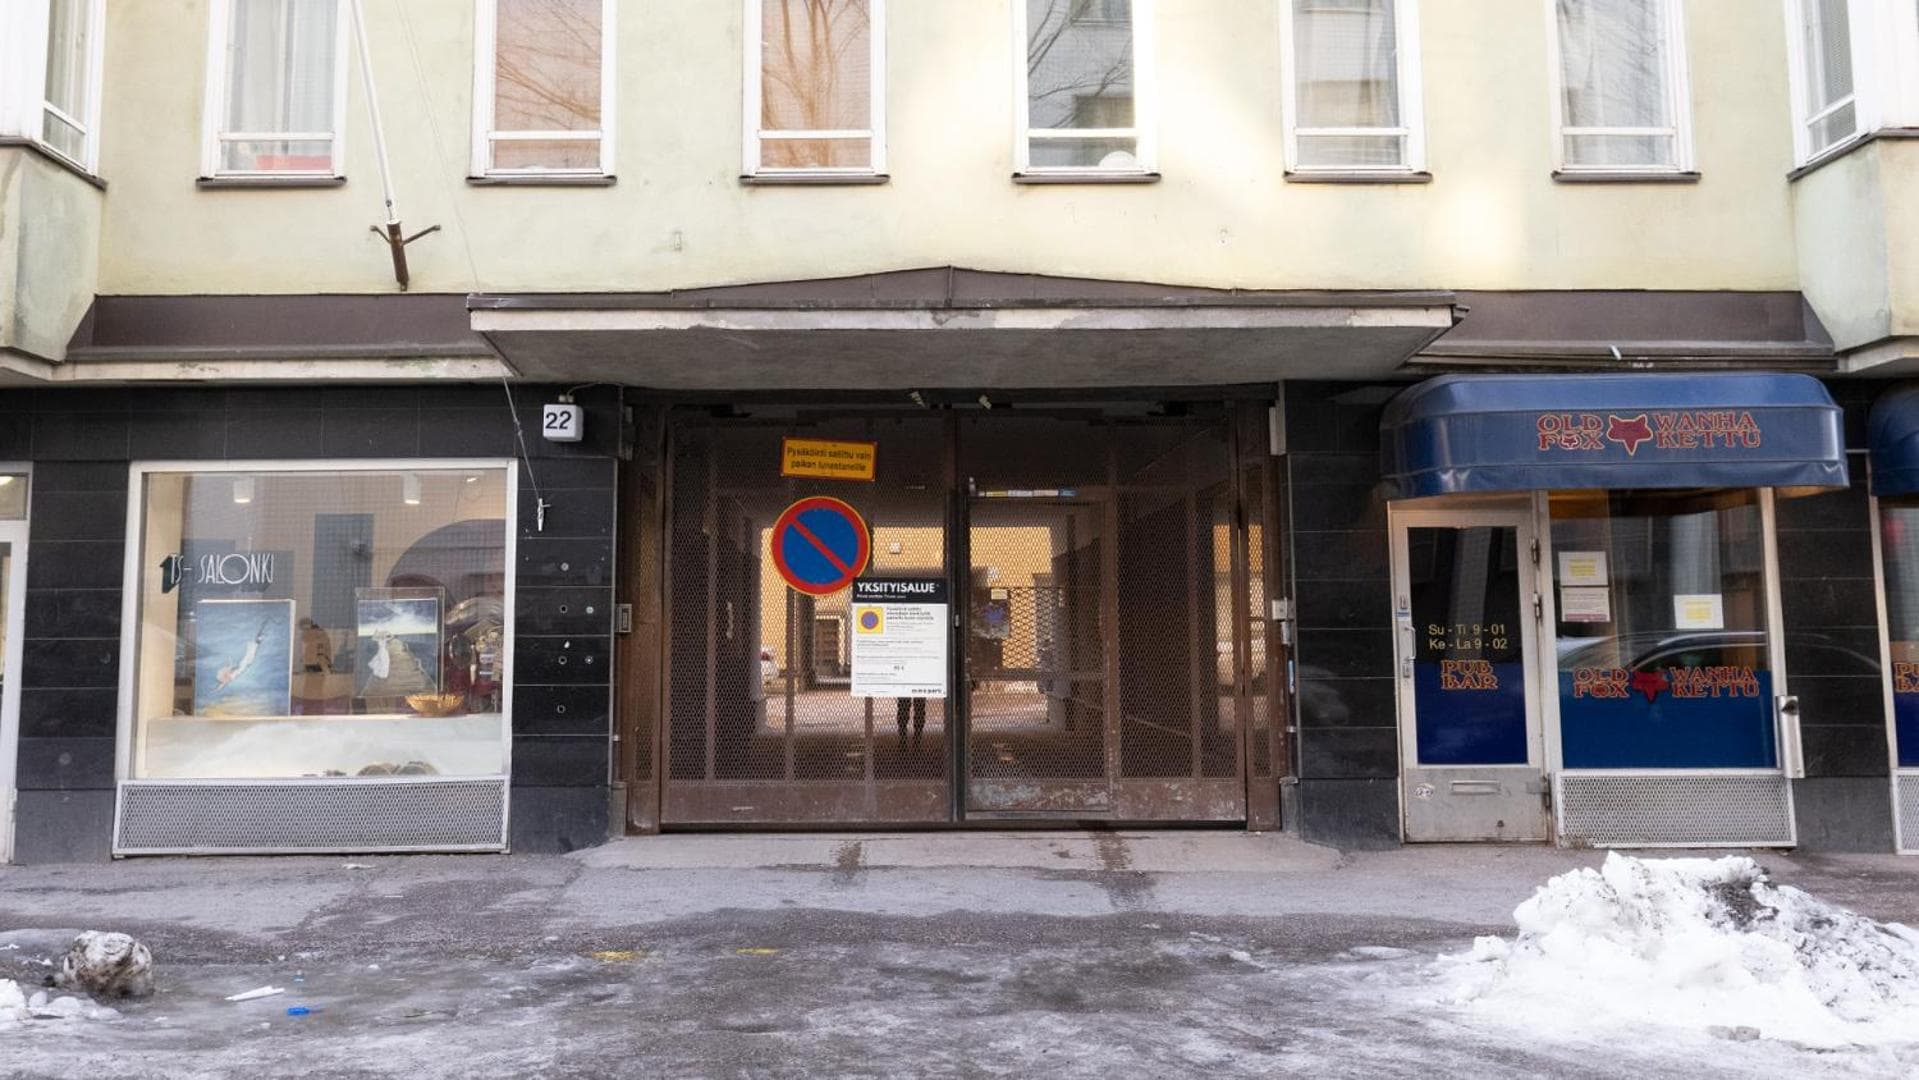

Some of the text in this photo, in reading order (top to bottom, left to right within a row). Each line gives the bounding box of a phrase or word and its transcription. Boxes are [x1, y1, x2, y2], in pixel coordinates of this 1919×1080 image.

[545, 411, 572, 430] 22
[1537, 414, 1604, 432] OLD
[1654, 411, 1760, 432] WANHA
[1537, 431, 1605, 450] FOX
[1656, 430, 1761, 448] KETTU
[198, 553, 275, 584] SALONKI
[857, 582, 935, 593] YKSITYISALUE
[1428, 624, 1444, 635] Su
[1456, 624, 1466, 634] Ti
[1473, 624, 1480, 635] 9
[1491, 624, 1505, 635] 01
[1429, 638, 1446, 650] Ke
[1456, 639, 1471, 649] La
[1474, 639, 1481, 649] 9
[1492, 639, 1508, 649] 02
[1442, 660, 1493, 674] PUB
[1574, 667, 1629, 682] OLD
[1670, 667, 1756, 683] WANHA
[1442, 673, 1499, 690] BAR
[1574, 681, 1630, 698] FOX
[1672, 681, 1760, 697] KETTU
